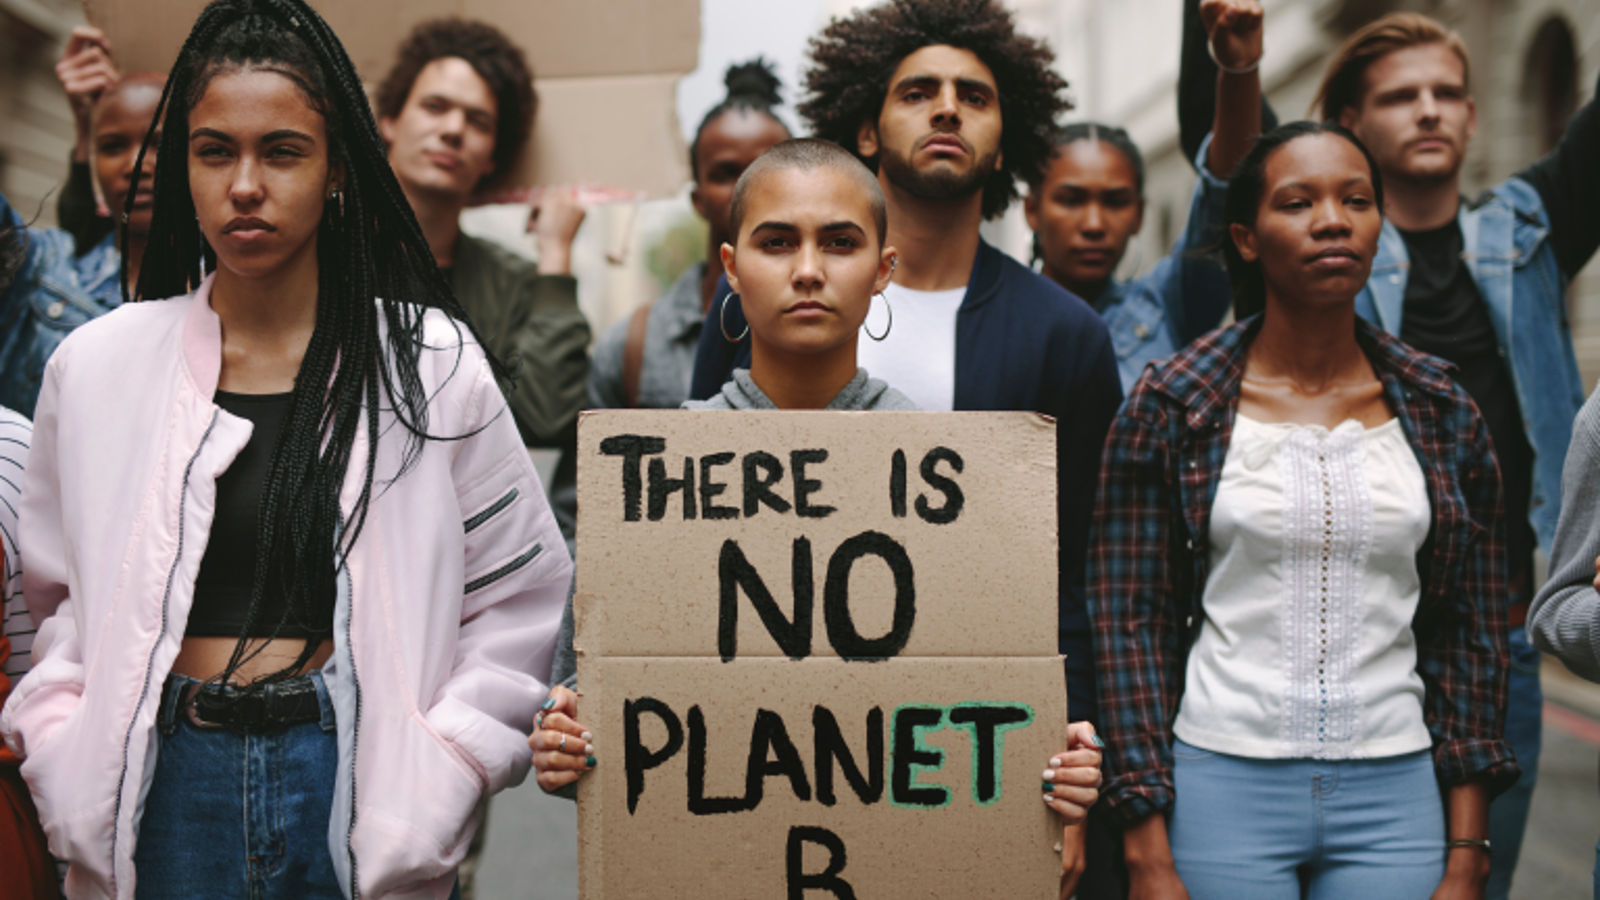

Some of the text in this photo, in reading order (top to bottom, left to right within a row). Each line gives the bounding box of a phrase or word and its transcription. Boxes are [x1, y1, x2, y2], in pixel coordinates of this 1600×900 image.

[600, 435, 965, 525] THERE IS
[718, 530, 916, 663] NO
[624, 697, 1035, 816] PLANET
